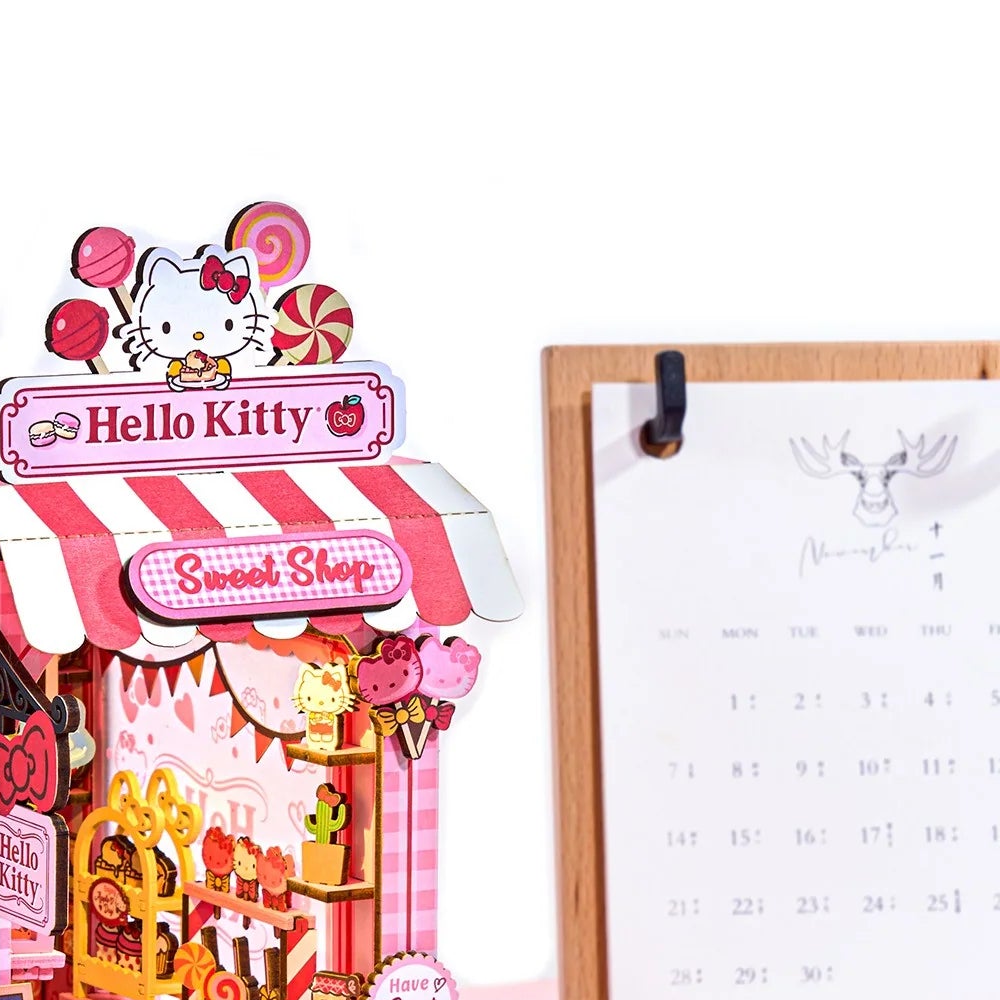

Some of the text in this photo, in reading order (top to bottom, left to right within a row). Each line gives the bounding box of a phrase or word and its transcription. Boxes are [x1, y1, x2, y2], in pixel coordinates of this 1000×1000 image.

[85, 399, 313, 443] Hello Kitty
[174, 545, 375, 594] Sweet Shop
[658, 627, 690, 640] SUN
[721, 626, 759, 640] MON
[790, 625, 819, 639] TUE
[854, 624, 888, 638] WED
[920, 624, 952, 637] THU
[794, 692, 806, 711] 2
[860, 692, 871, 709] 3
[923, 692, 935, 707] 4
[732, 762, 743, 778] 8
[796, 761, 808, 778] 9
[858, 760, 879, 776] 10
[922, 759, 941, 775] 11
[667, 829, 686, 846] 14
[730, 829, 751, 846] 15
[795, 828, 816, 845] 16
[860, 827, 880, 844] 17
[925, 826, 946, 843] 18
[0, 832, 39, 871] Hello
[667, 900, 686, 916] 21
[732, 899, 754, 915] 22
[796, 898, 819, 914] 23
[863, 896, 884, 913] 24
[927, 895, 949, 912] 25
[735, 967, 756, 984] 29
[800, 966, 822, 983] 30
[389, 978, 429, 993] Have
